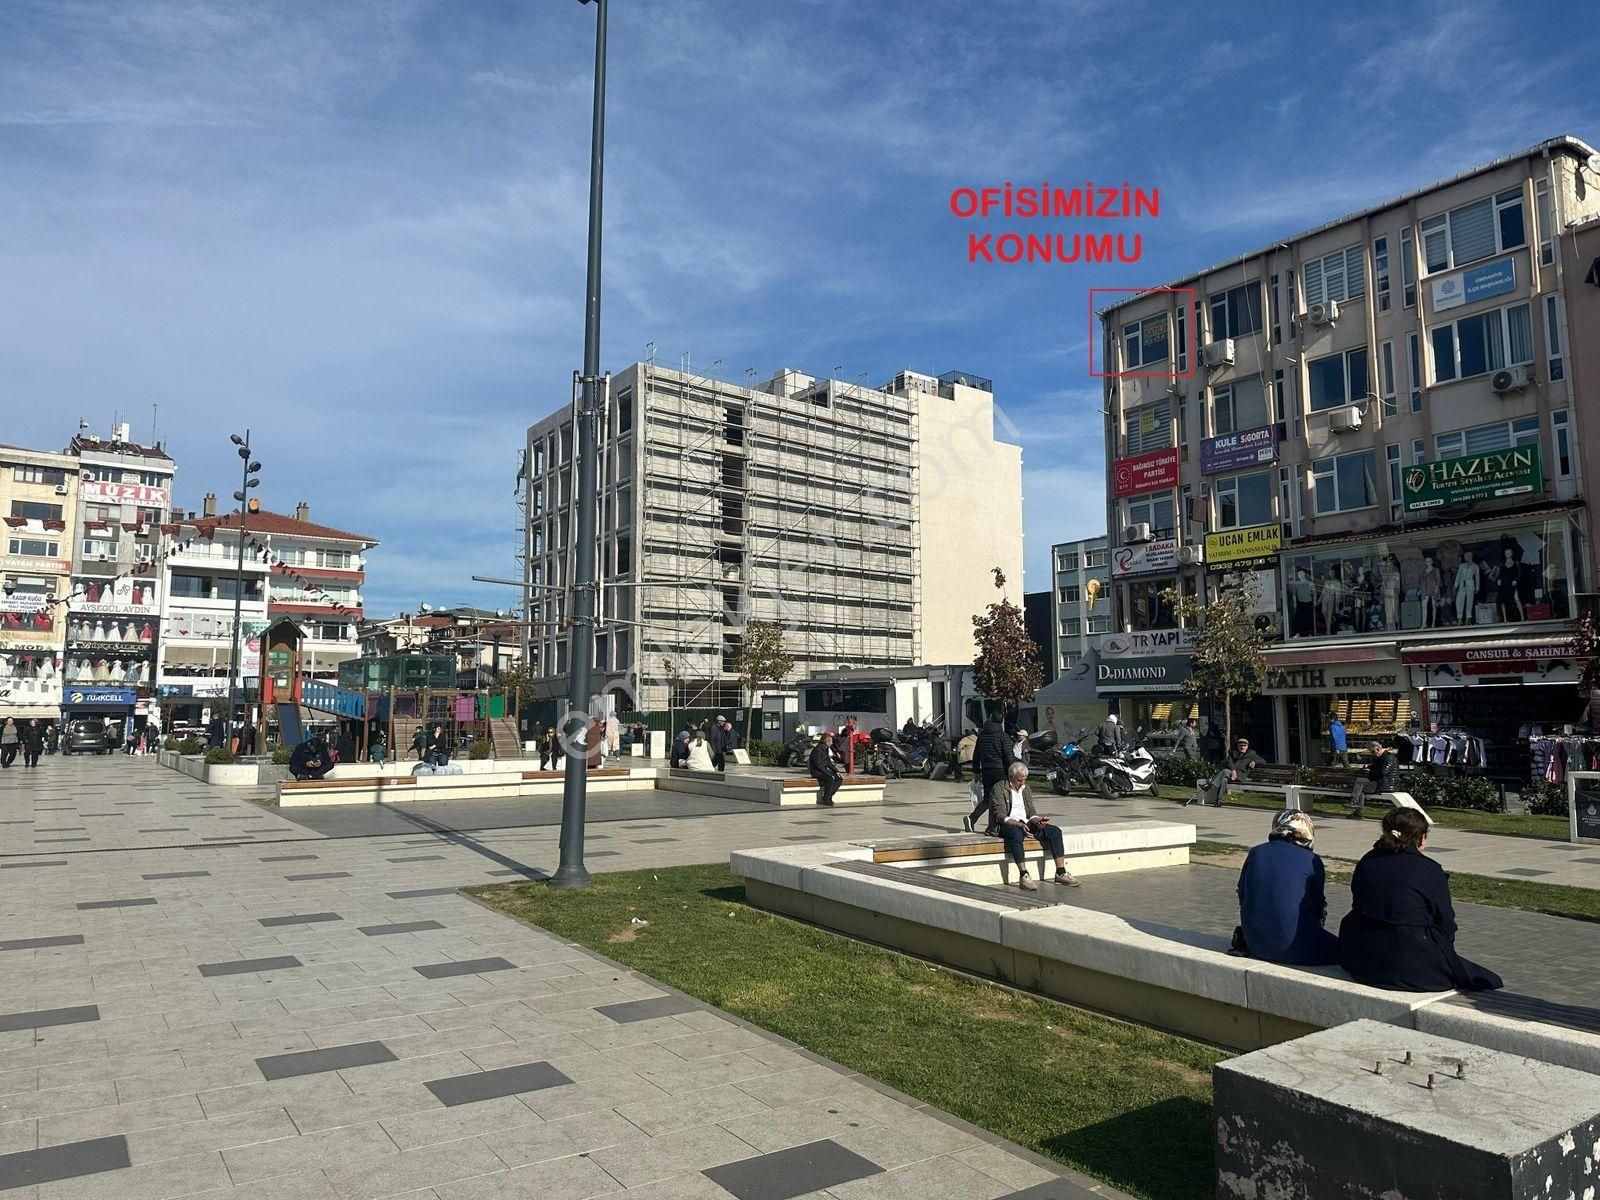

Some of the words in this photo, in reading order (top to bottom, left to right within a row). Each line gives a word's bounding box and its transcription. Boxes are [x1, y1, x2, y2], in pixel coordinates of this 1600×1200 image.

[1215, 436, 1238, 449] KULE
[1132, 460, 1155, 472] BAĞIMSIZ
[1155, 454, 1176, 467] TÜRKİYE
[1429, 448, 1532, 482] HAZEYN
[1143, 466, 1166, 479] PARTİSİ
[1247, 527, 1279, 543] EMLAK
[1149, 542, 1175, 551] SADAKA
[123, 606, 151, 614] AYDIN
[1132, 635, 1149, 647] TR
[1150, 631, 1180, 646] YAPI
[1466, 649, 1510, 660] CANSUR
[1512, 649, 1522, 658] &
[86, 693, 123, 702] TURKCELL
